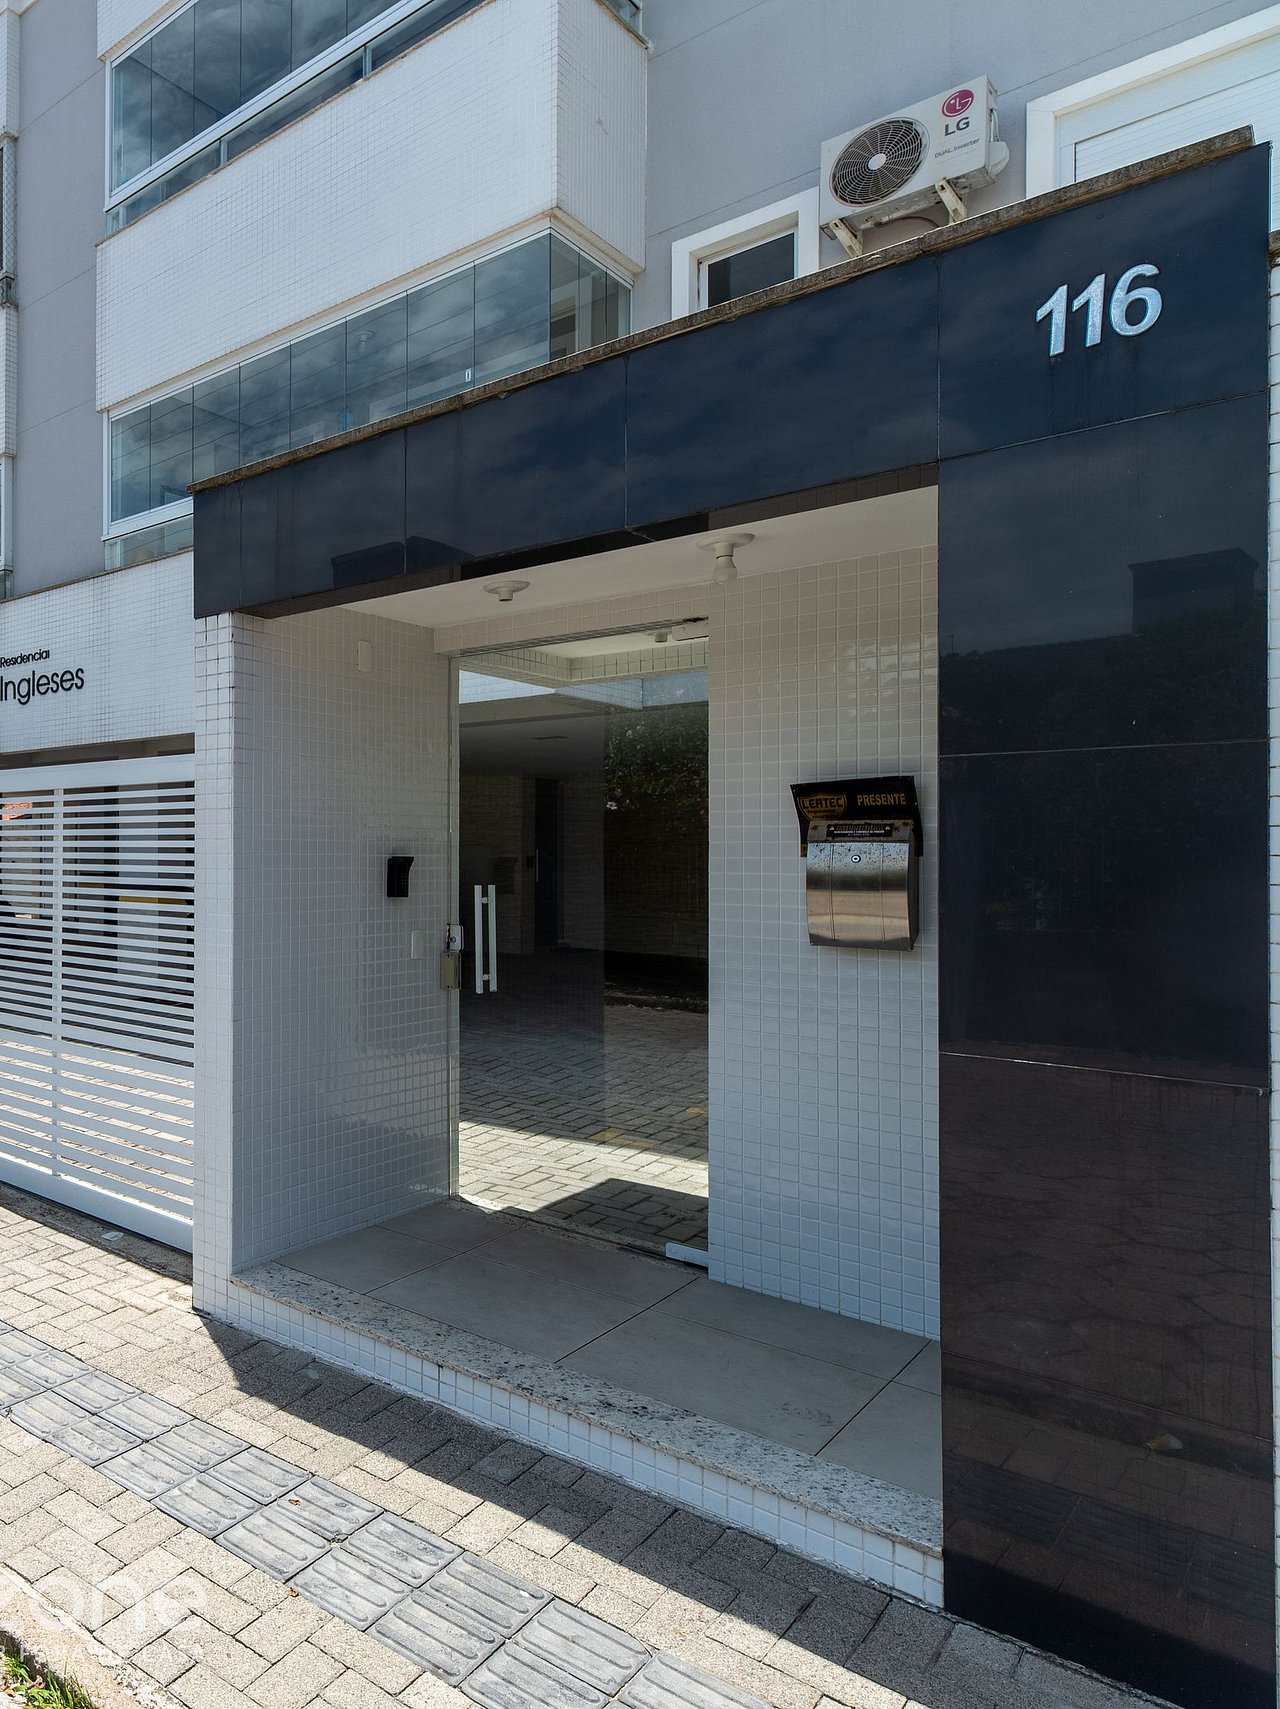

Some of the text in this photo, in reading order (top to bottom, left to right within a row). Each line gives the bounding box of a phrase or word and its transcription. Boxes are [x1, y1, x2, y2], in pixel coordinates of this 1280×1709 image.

[945, 116, 970, 136] LG
[1036, 263, 1163, 357] 116
[0, 648, 50, 668] Residencial
[0, 667, 85, 706] Ingleses
[857, 793, 907, 807] PRESENTE
